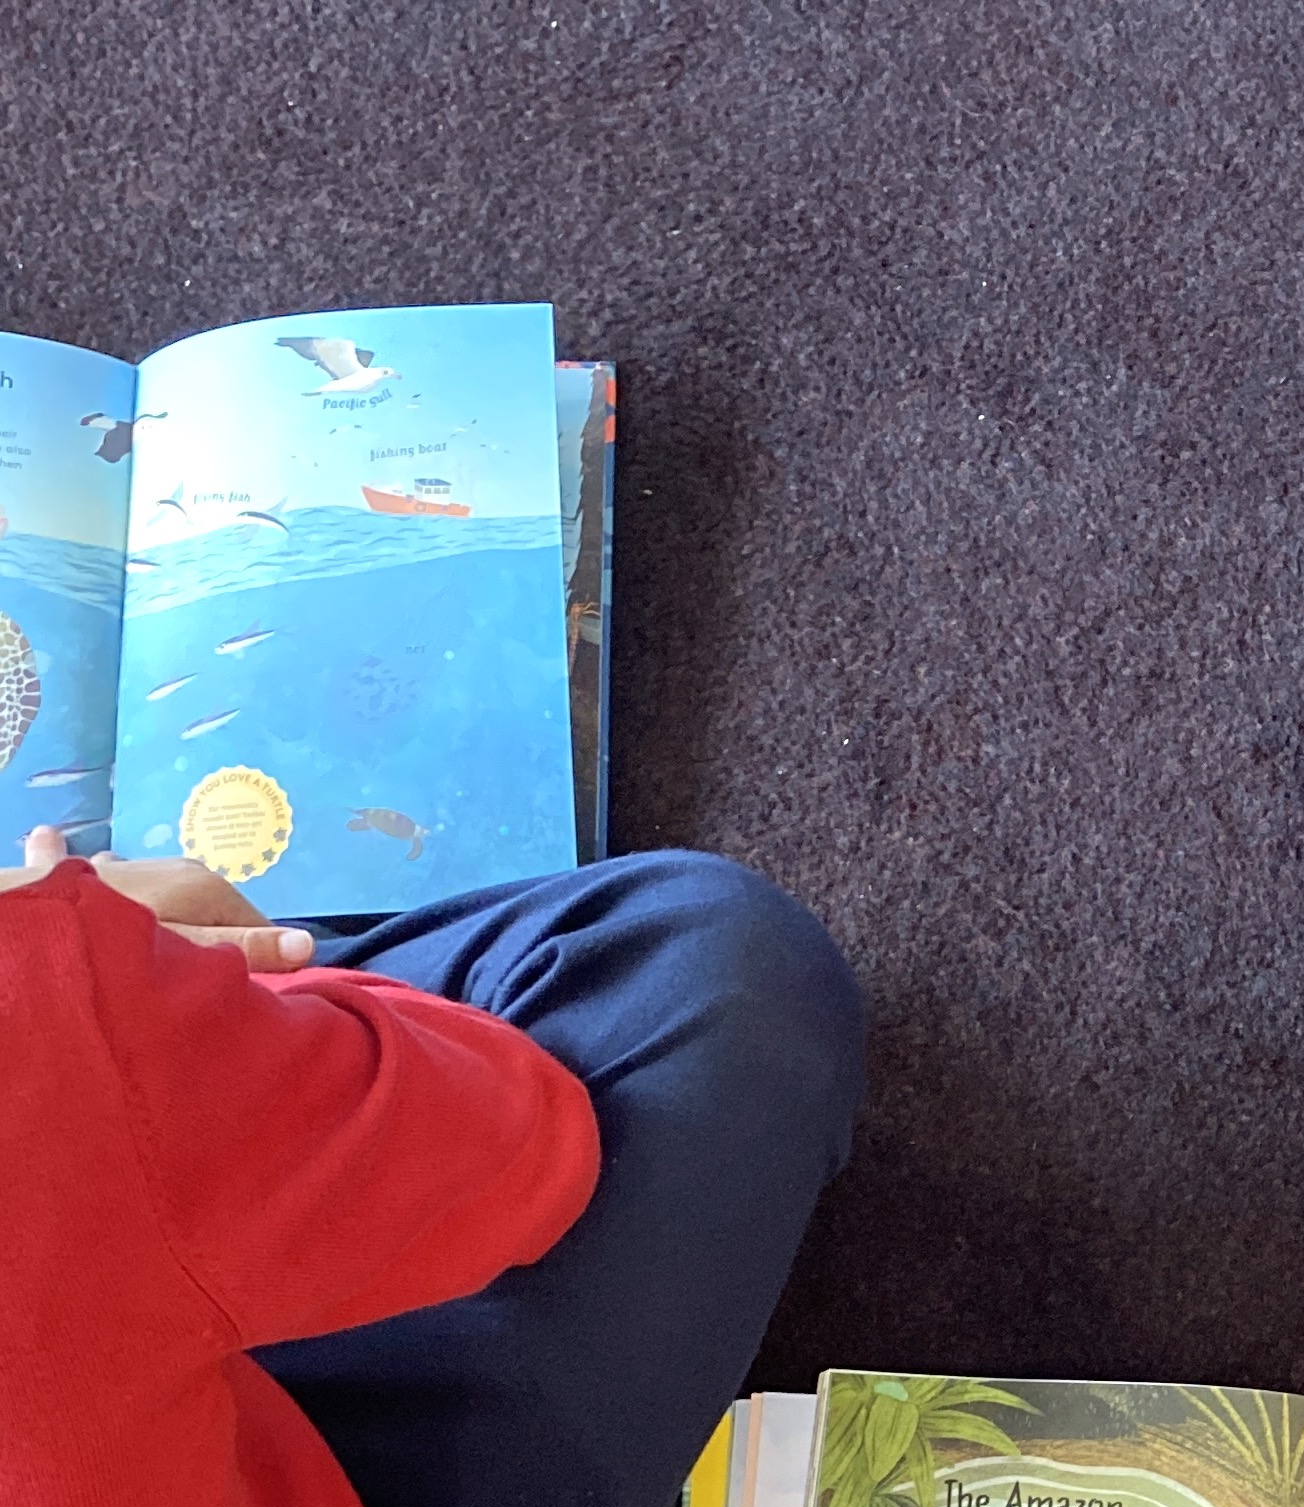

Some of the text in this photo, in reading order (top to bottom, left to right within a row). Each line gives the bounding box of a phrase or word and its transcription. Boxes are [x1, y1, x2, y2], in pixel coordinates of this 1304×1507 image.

[323, 388, 393, 411] Pacific gull
[370, 443, 447, 462] fishing boat
[200, 779, 220, 796] YOU
[223, 773, 252, 784] LOVE
[253, 778, 261, 787] A
[261, 782, 286, 821] TURTLE
